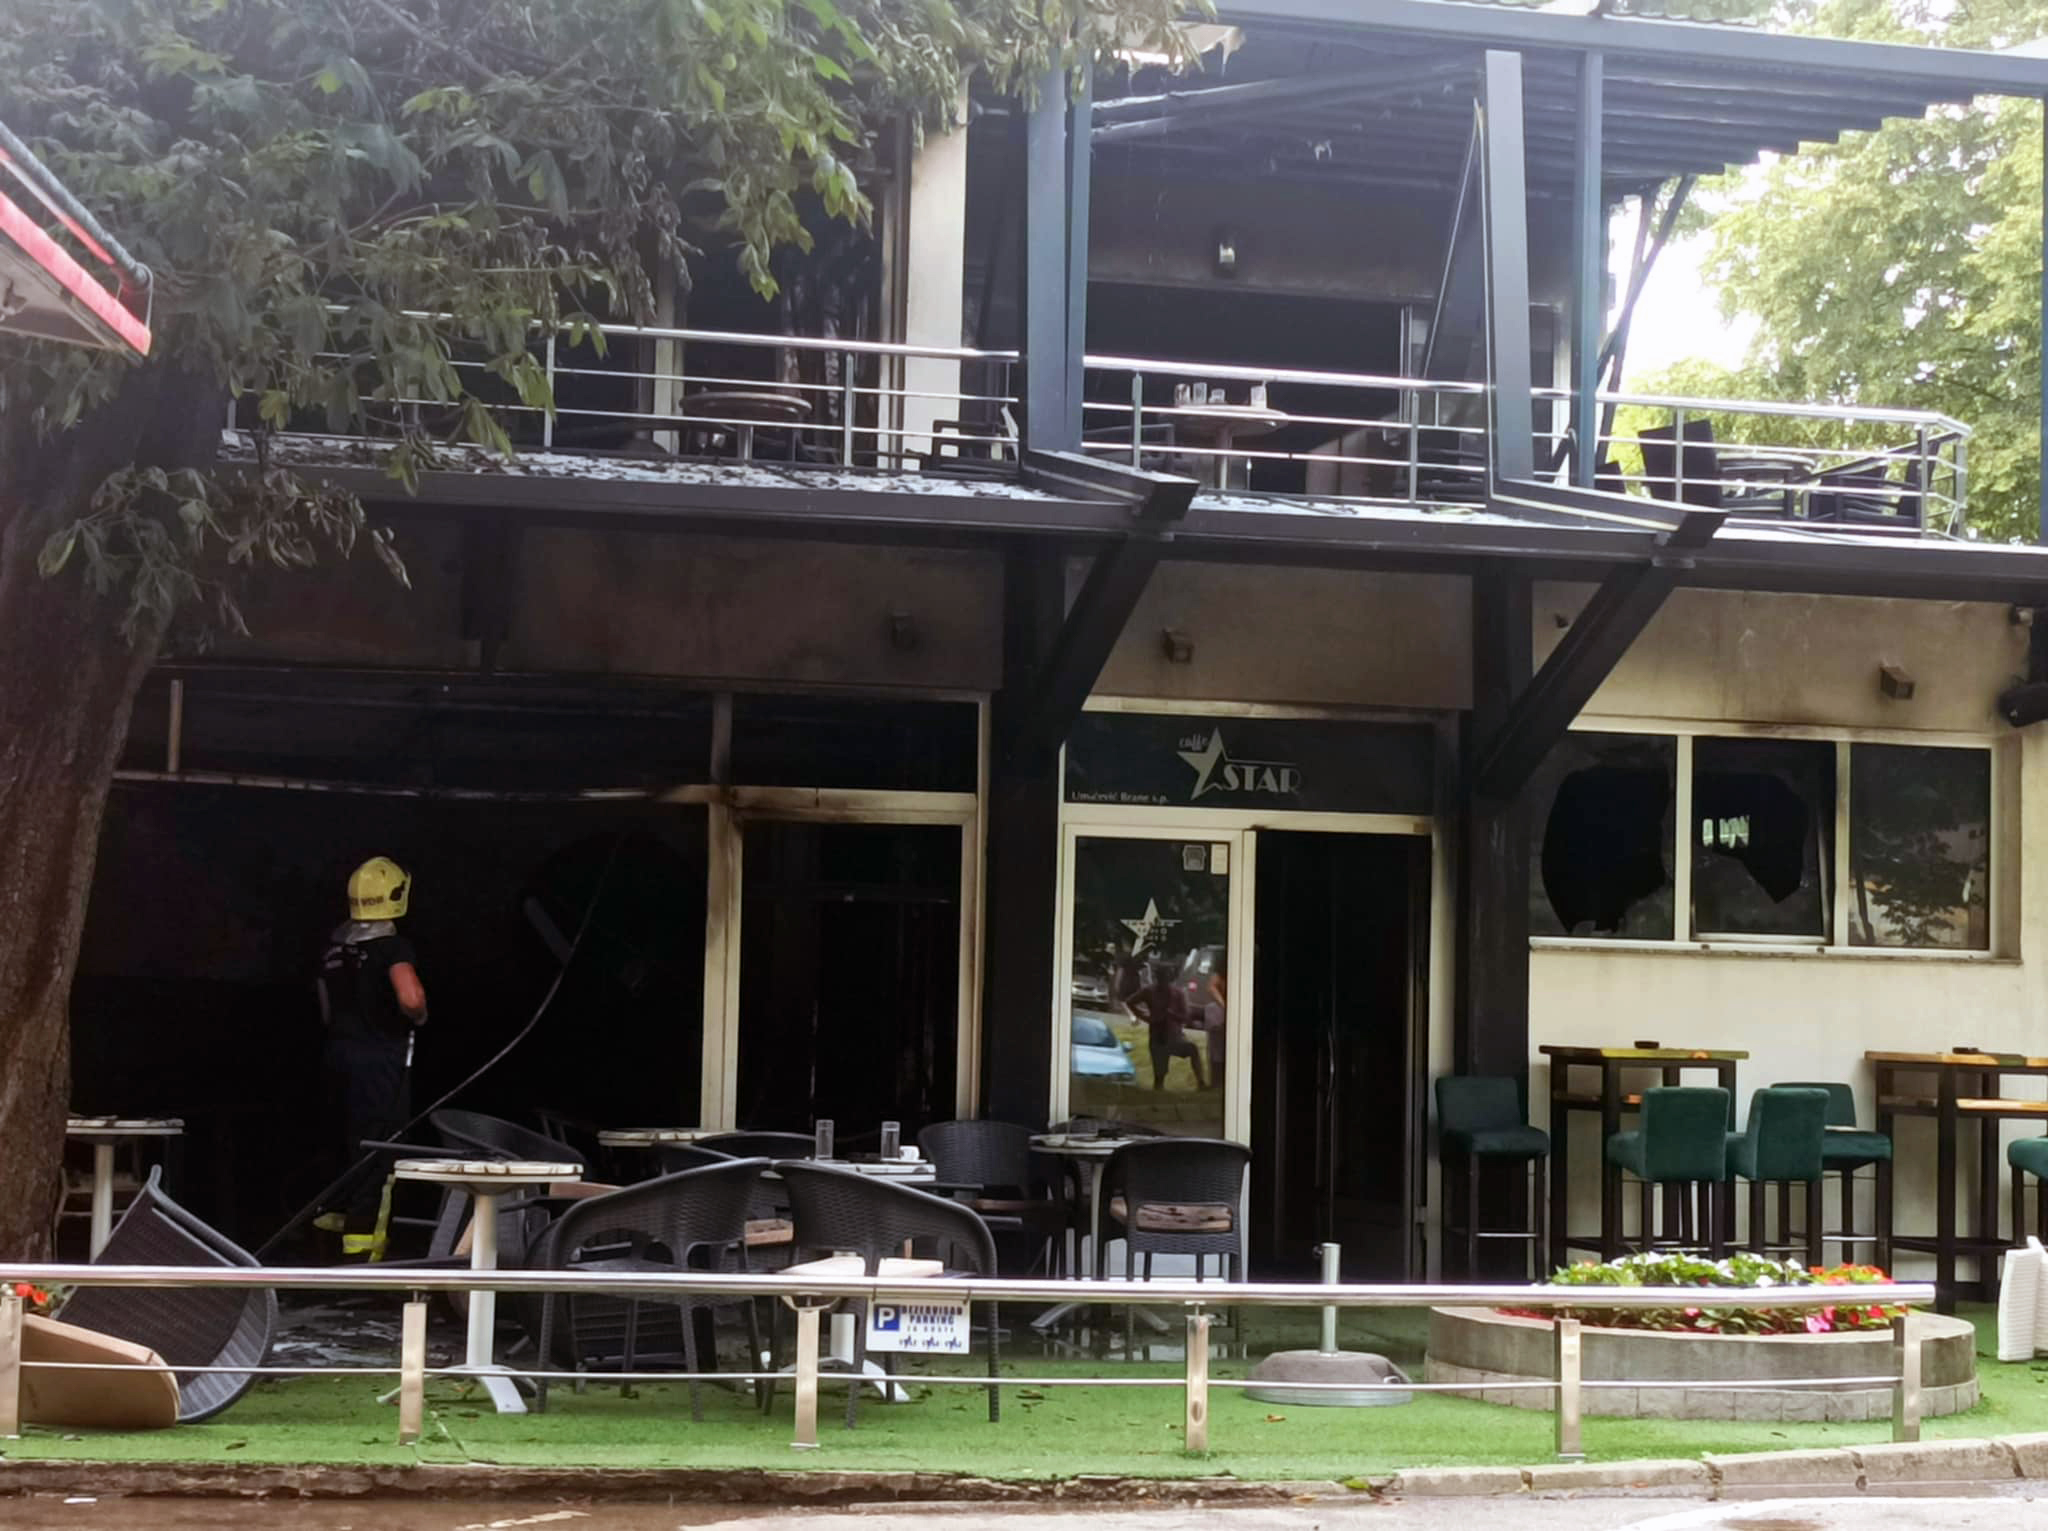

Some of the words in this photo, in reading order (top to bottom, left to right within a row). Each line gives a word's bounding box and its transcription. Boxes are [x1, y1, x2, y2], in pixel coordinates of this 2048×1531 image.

[1223, 763, 1302, 794] STAR
[878, 1307, 895, 1329] P
[910, 1315, 954, 1324] PARKING
